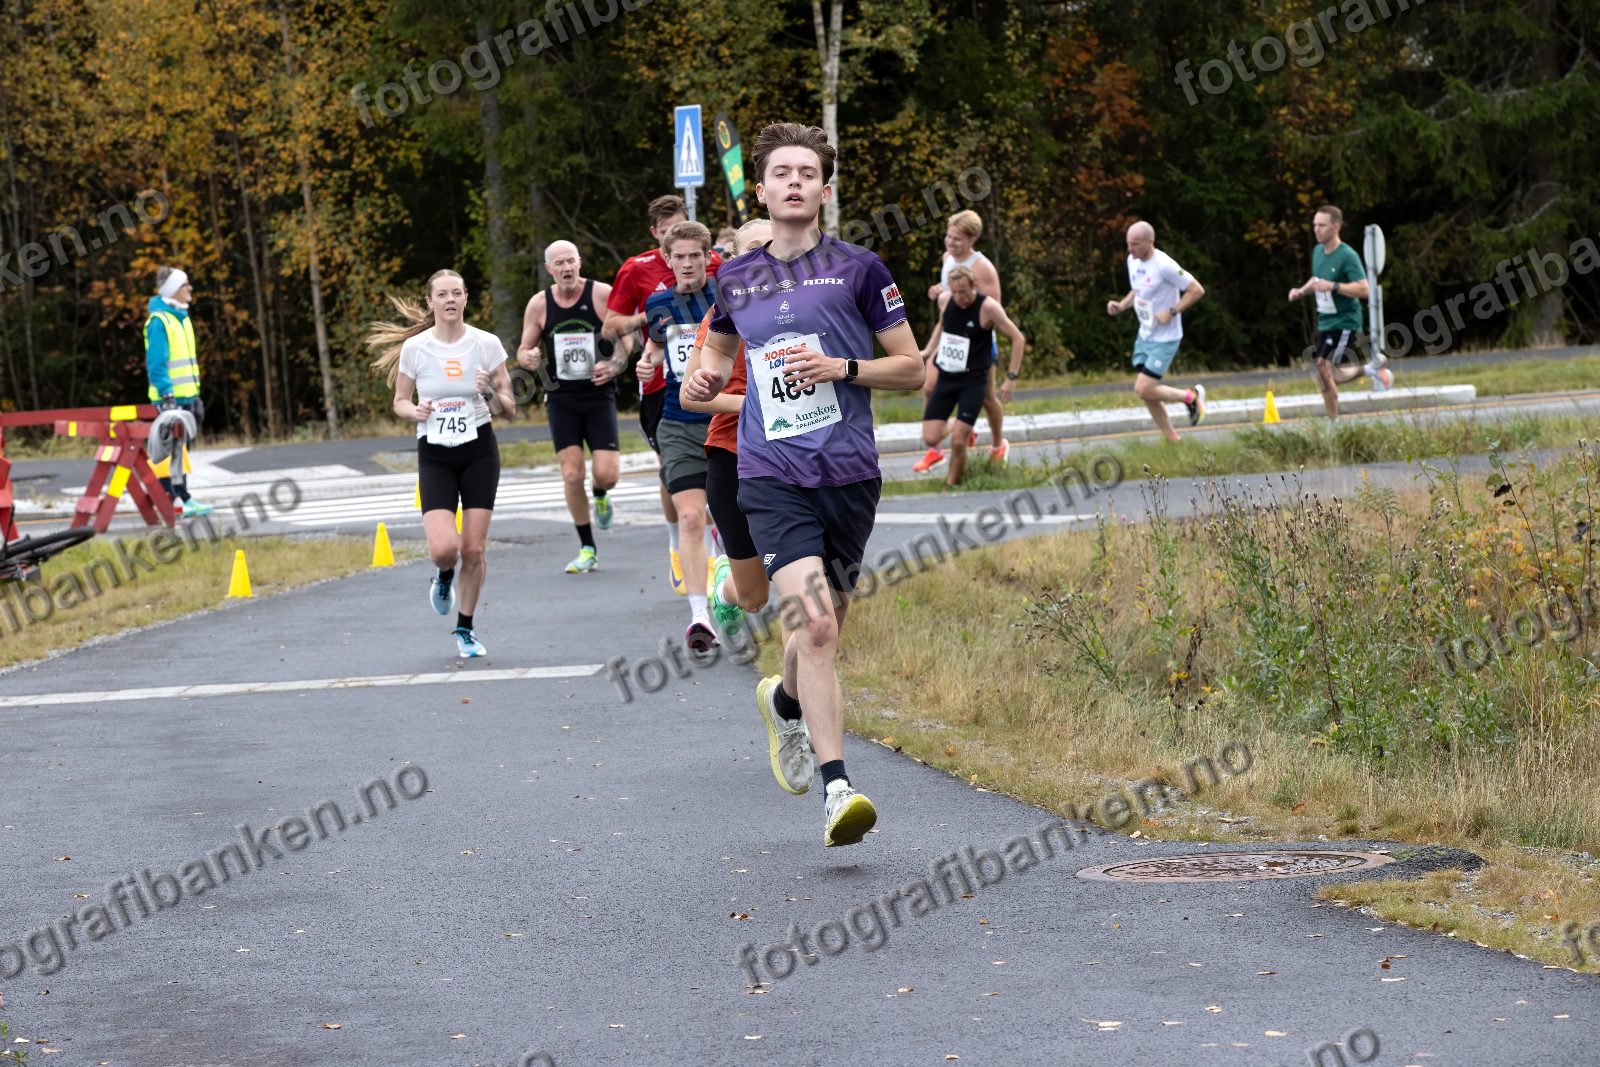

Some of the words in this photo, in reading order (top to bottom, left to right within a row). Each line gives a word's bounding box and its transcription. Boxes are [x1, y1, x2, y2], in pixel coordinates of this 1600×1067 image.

[803, 277, 845, 286] ADAX
[563, 349, 586, 363] 603
[942, 345, 965, 361] 1000
[795, 403, 837, 423] Aurskog
[436, 416, 467, 434] 745
